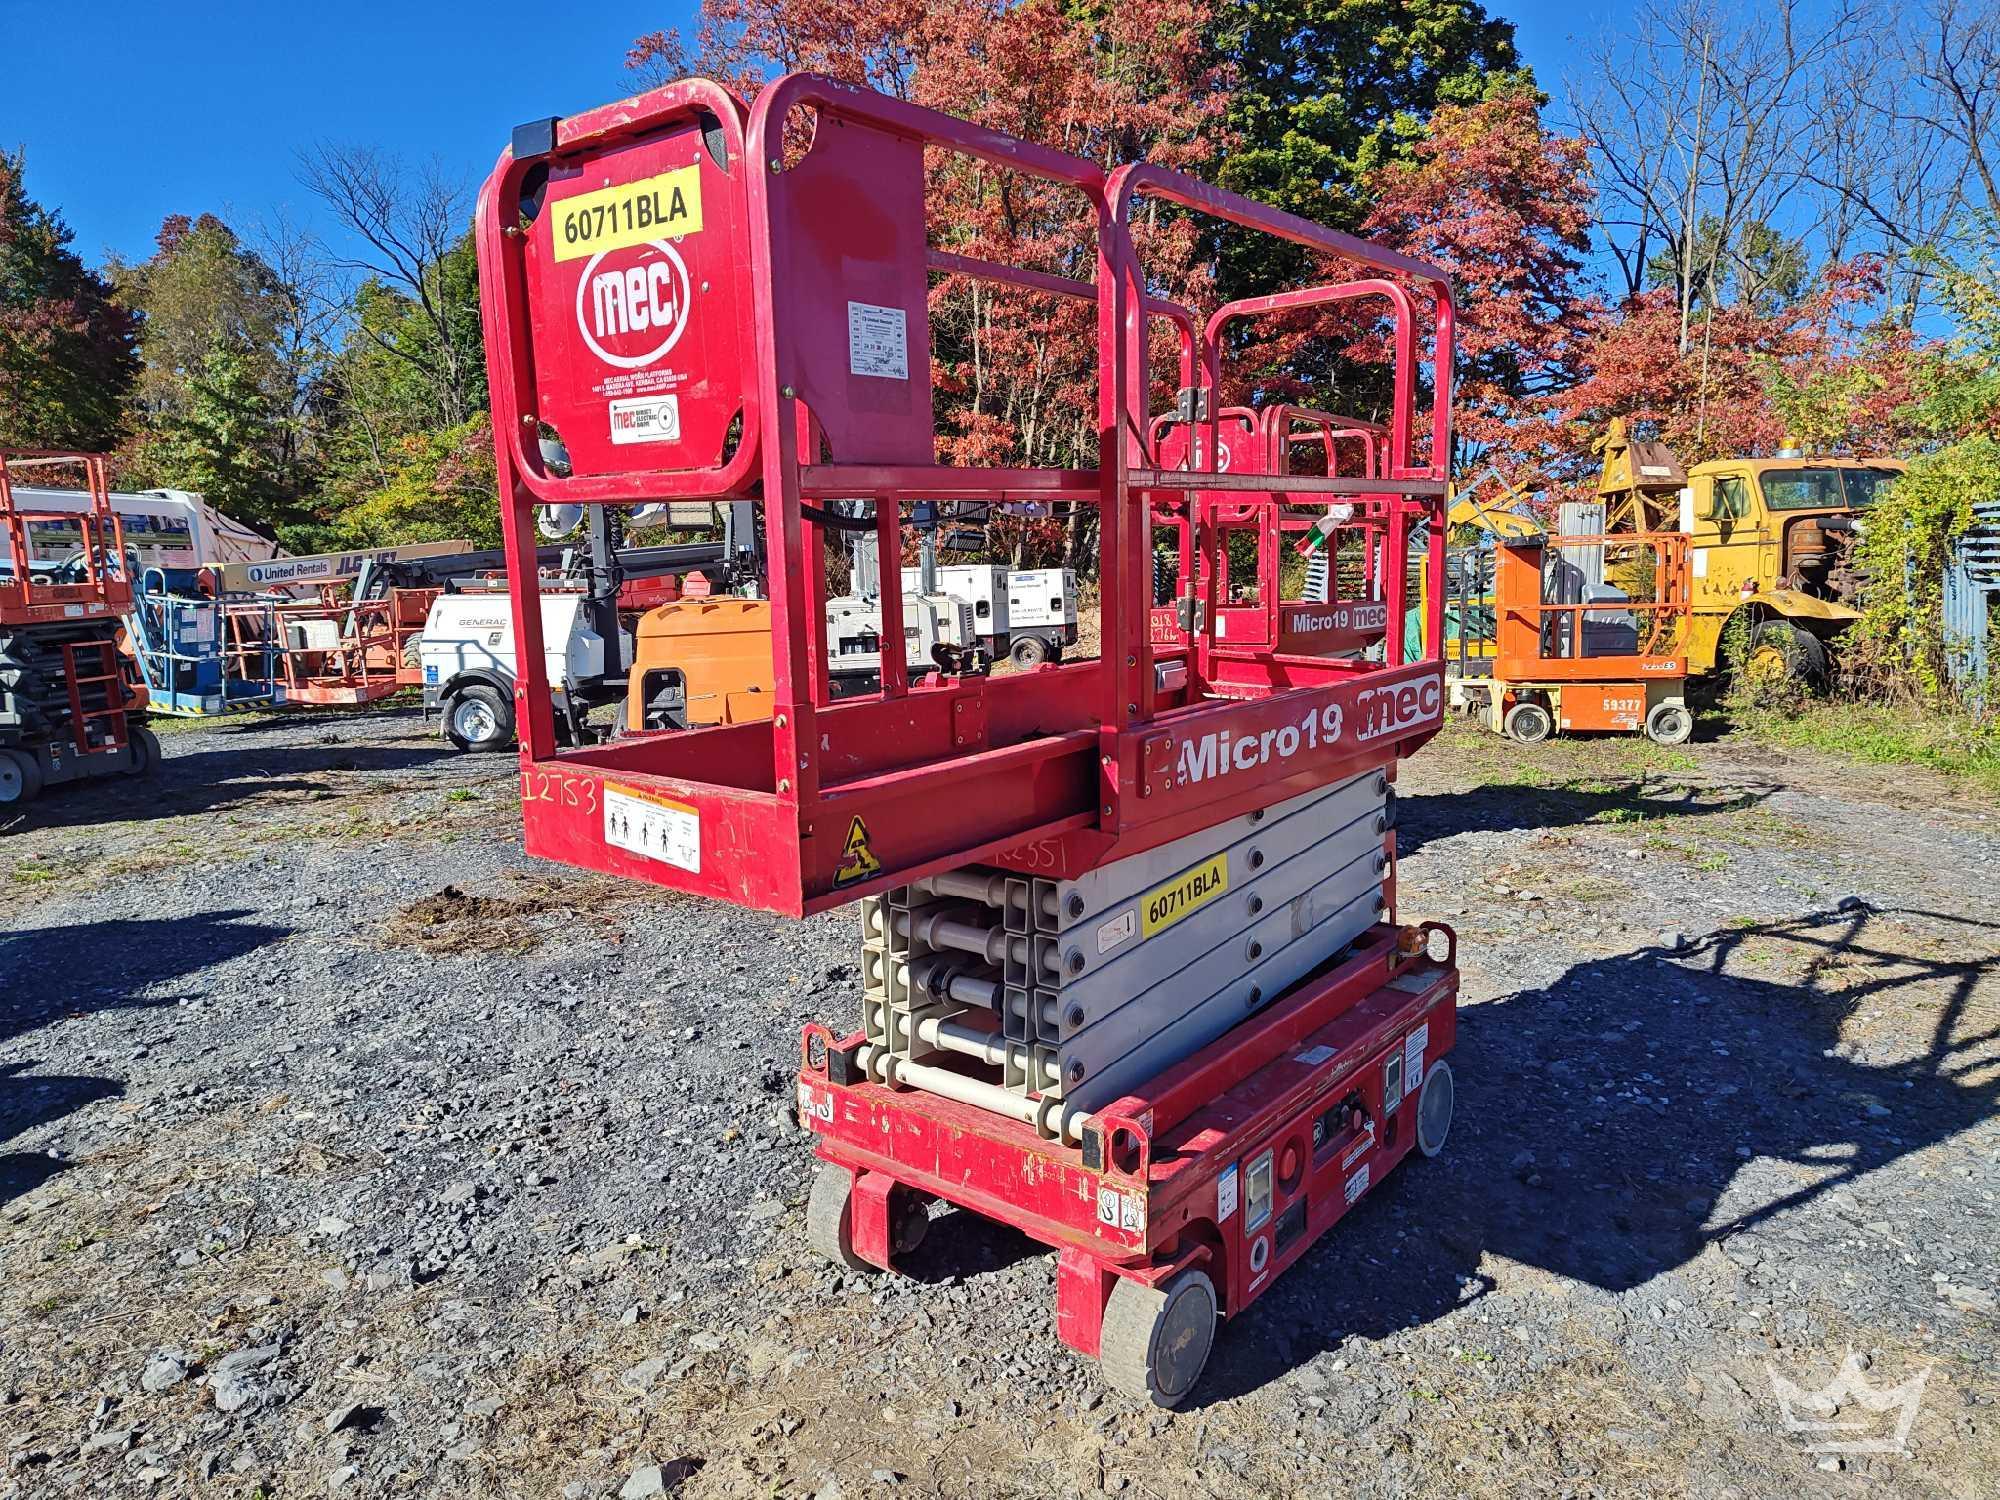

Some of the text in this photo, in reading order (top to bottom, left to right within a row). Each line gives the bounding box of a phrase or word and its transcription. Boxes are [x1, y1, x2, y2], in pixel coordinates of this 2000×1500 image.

[564, 186, 688, 244] 60711BLA
[592, 260, 673, 337] mec
[613, 411, 636, 430] mec
[264, 562, 328, 579] United Rentals
[335, 555, 363, 575] JLG
[459, 618, 508, 626] GENERAC
[1293, 605, 1386, 632] Micro19 mec
[1603, 699, 1642, 711] 59377
[1178, 676, 1440, 785] Micro19 mec
[1149, 866, 1221, 924] 60711BLA
